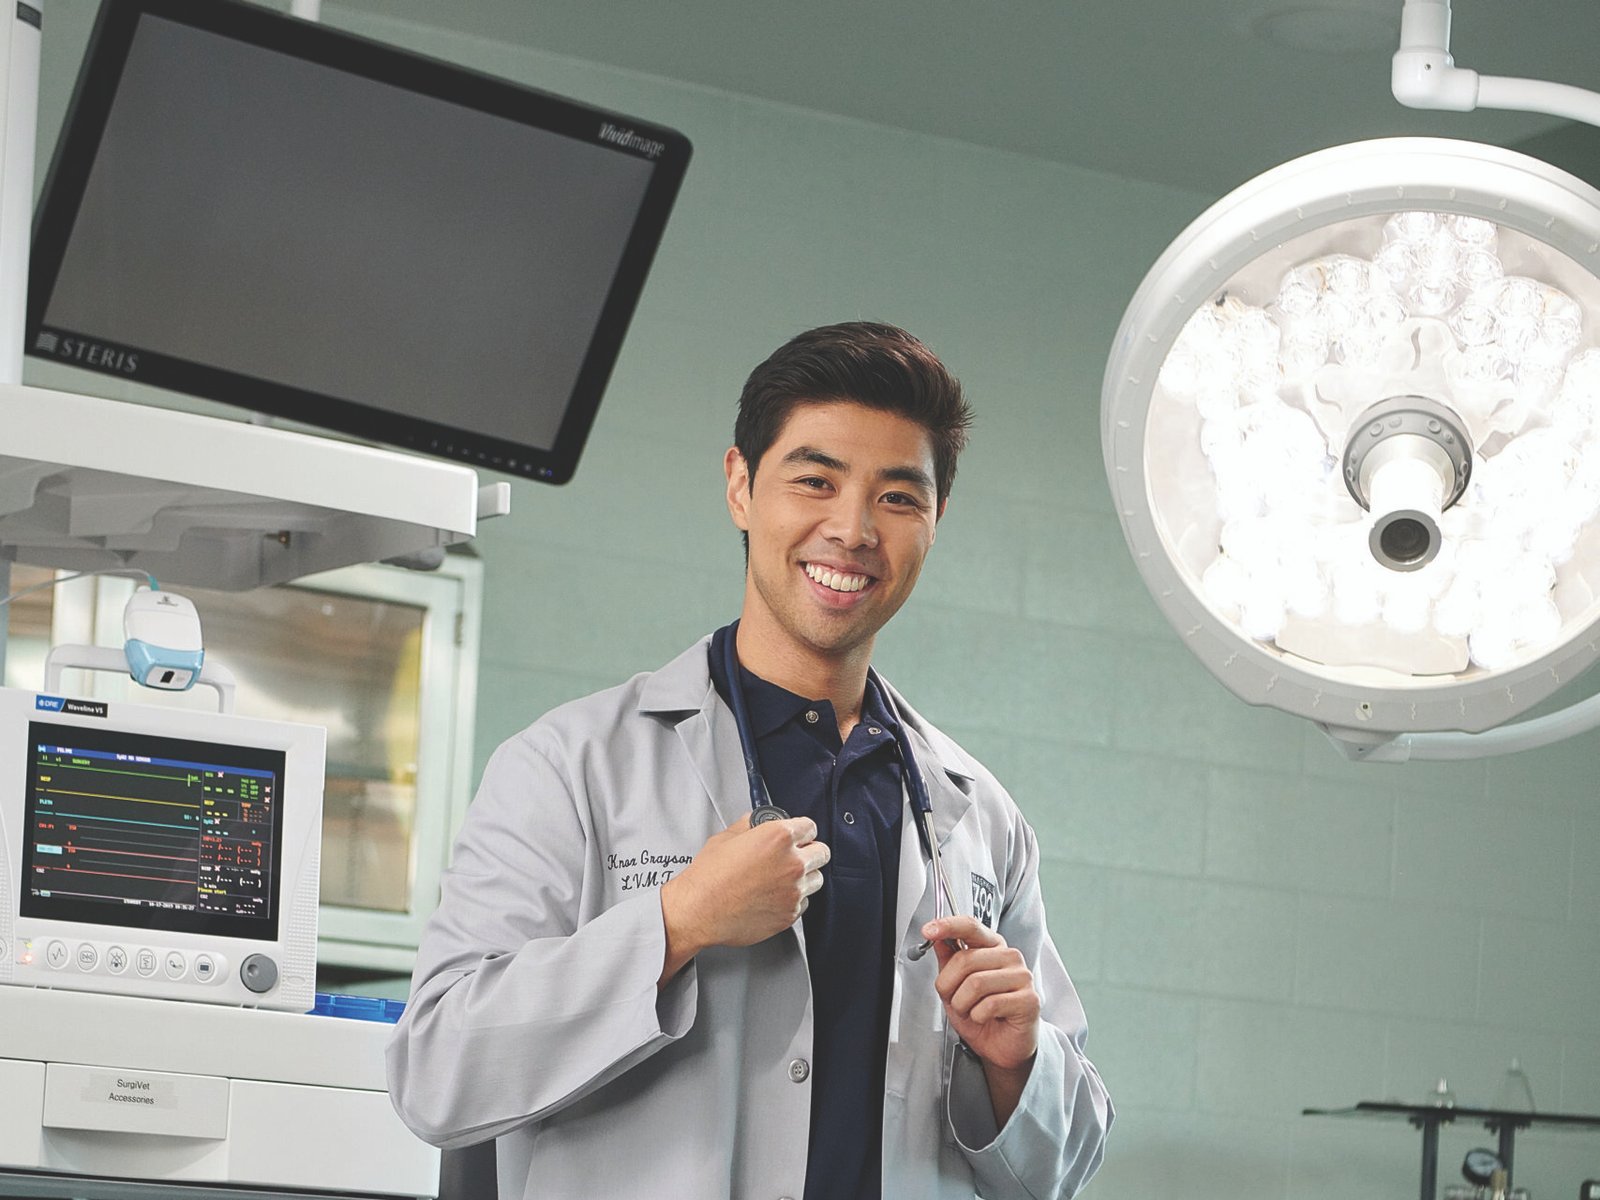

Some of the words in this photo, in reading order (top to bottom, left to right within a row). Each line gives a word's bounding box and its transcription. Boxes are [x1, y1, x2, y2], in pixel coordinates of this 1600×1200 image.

[60, 338, 139, 373] STERIS
[45, 700, 59, 708] DRE
[607, 854, 637, 870] Knox
[640, 849, 693, 868] Grayson
[117, 1079, 150, 1090] SurgiVet
[108, 1092, 154, 1104] Accessories
